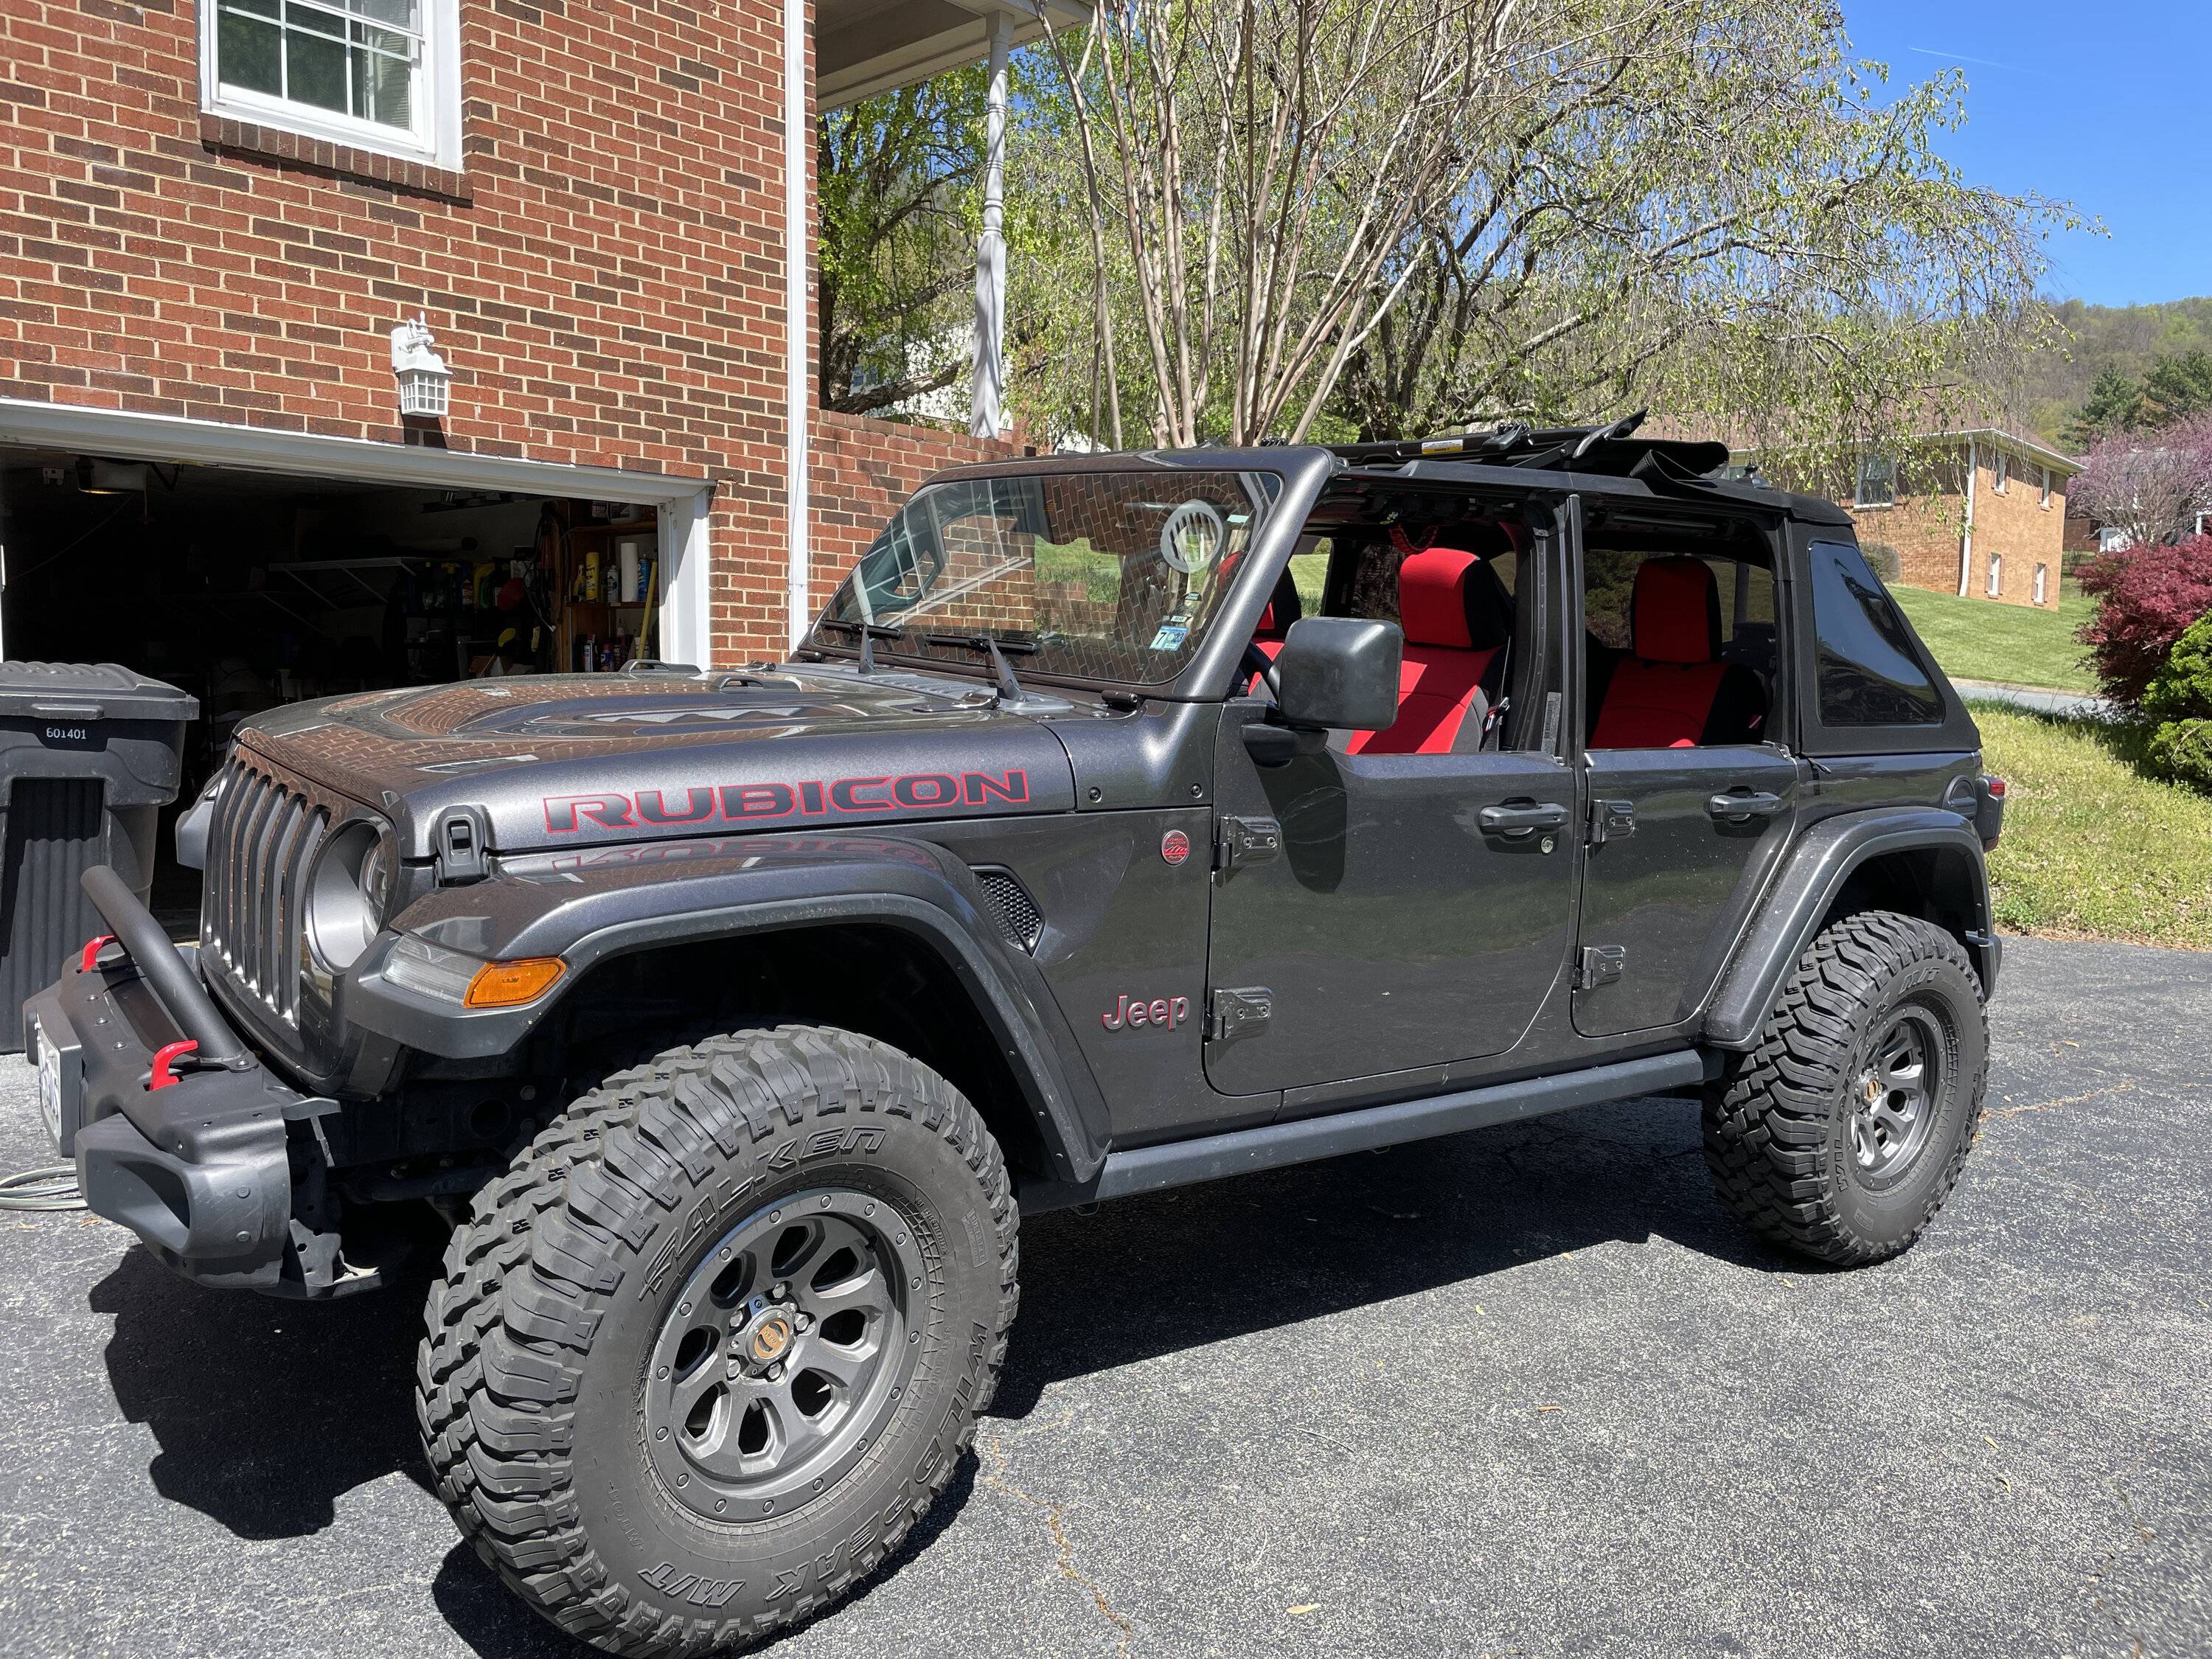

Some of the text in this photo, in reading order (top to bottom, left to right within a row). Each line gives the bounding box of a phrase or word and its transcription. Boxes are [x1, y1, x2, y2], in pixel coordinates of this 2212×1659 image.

[1156, 632, 1167, 645] 7
[46, 727, 86, 740] 601401
[543, 770, 1028, 833] RUBICON
[1102, 995, 1190, 1032] Jeep
[639, 1126, 886, 1301] FALKEN
[764, 1320, 990, 1602] WILDPEAK
[637, 1561, 746, 1608] M/T
